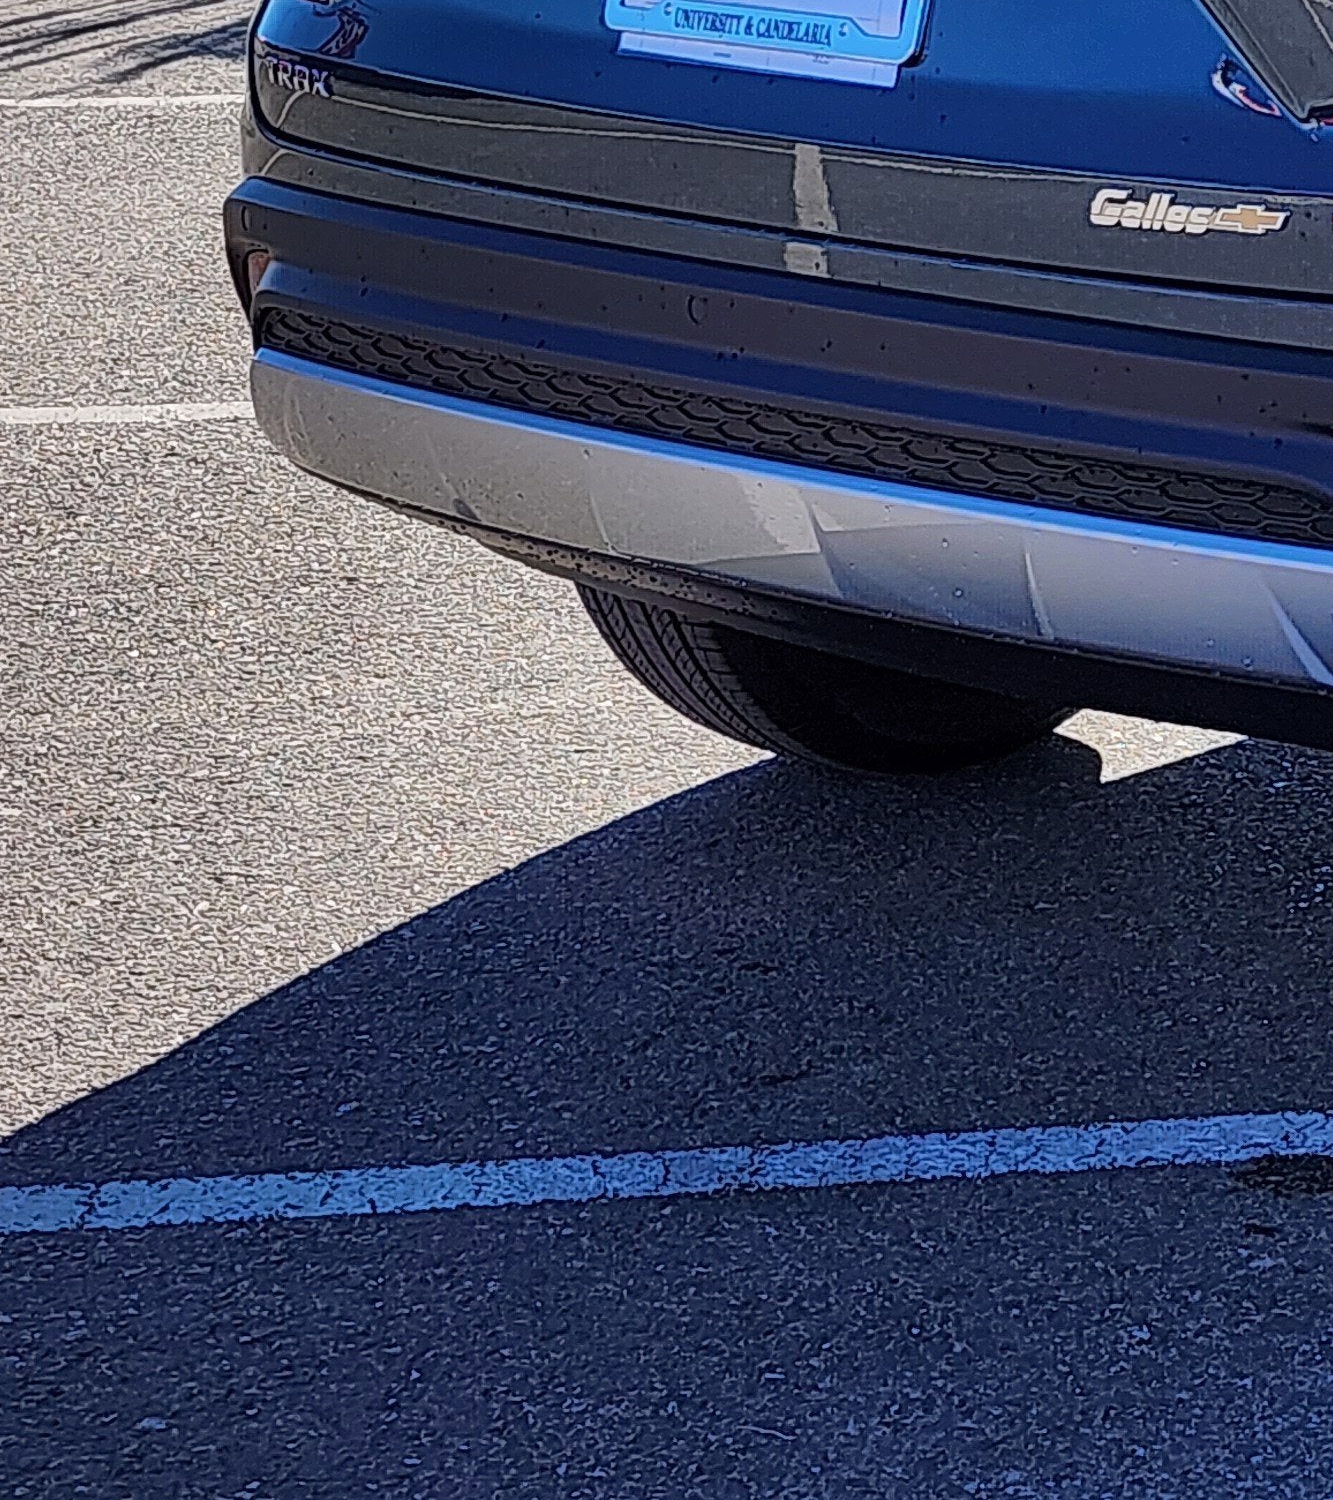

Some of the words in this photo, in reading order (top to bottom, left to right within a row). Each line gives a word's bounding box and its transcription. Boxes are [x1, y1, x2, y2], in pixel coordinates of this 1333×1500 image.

[744, 16, 754, 36] &
[755, 17, 832, 47] CANDELARIA
[265, 56, 329, 98] TRAX
[1090, 187, 1217, 234] Galles
